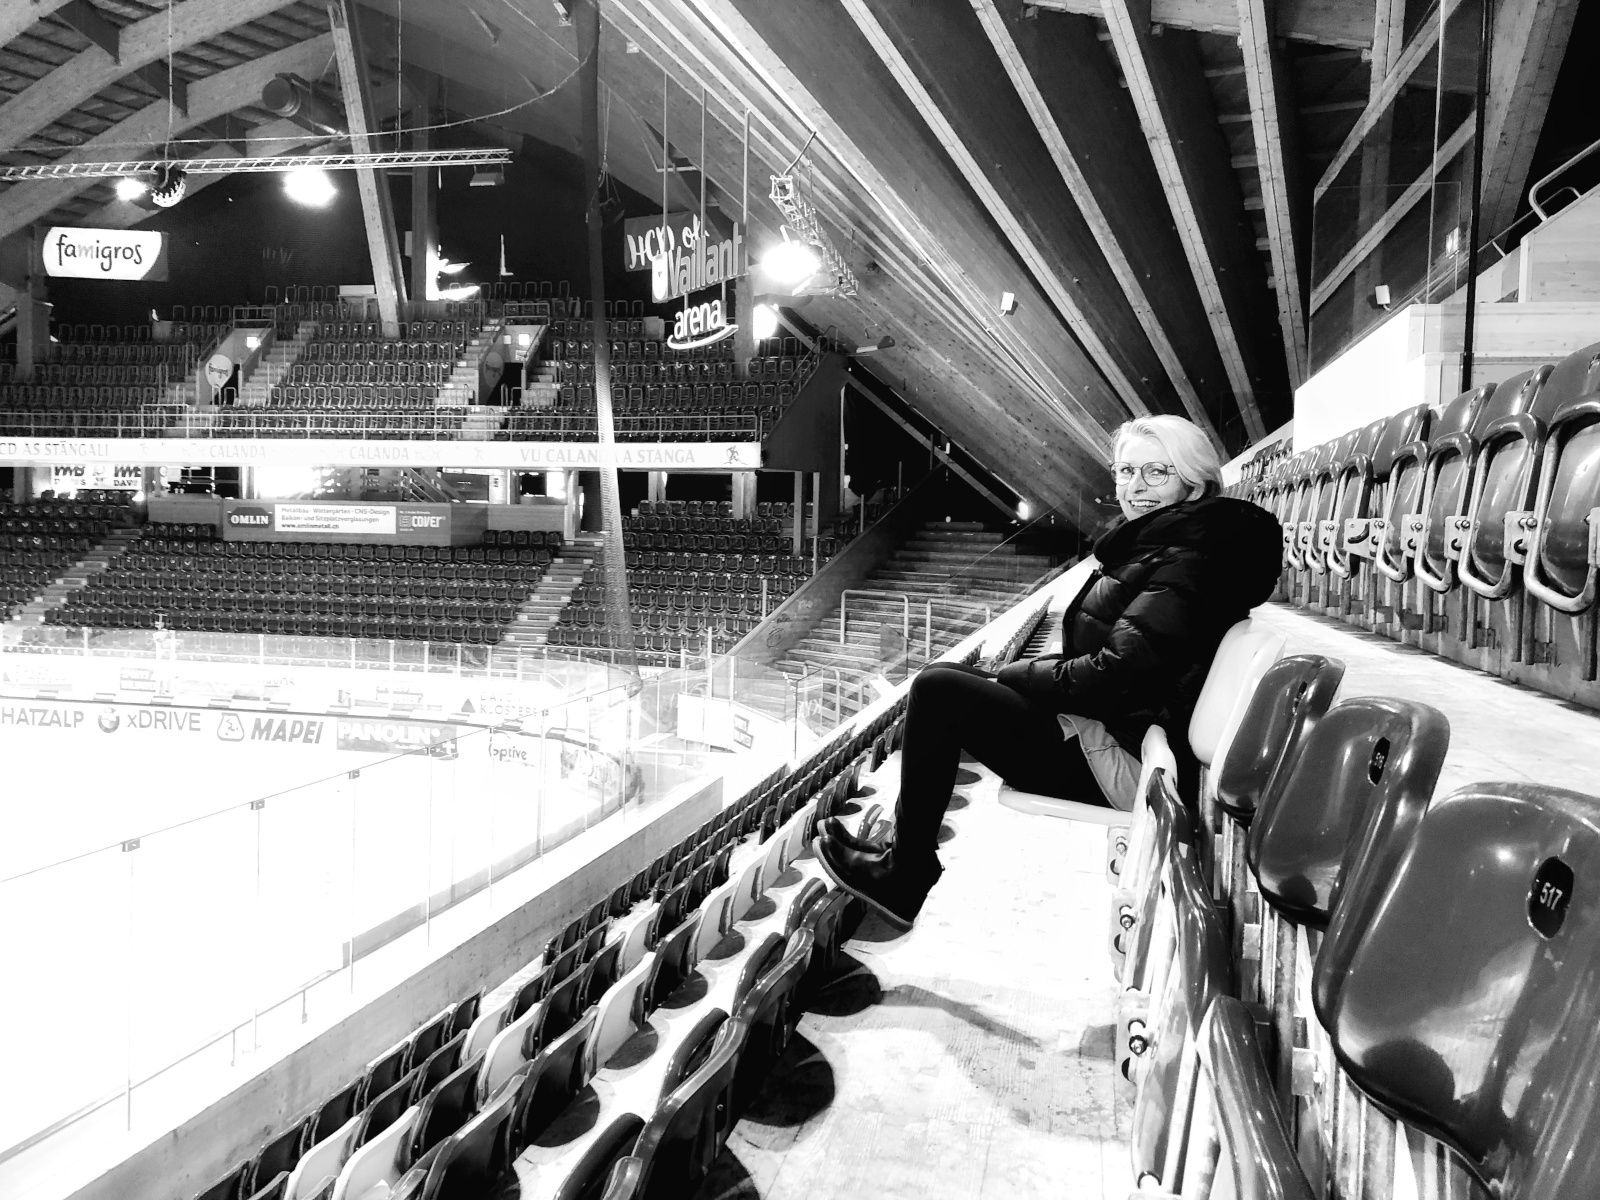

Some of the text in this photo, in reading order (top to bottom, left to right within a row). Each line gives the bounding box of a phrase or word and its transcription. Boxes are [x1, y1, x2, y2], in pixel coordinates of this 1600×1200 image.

[56, 234, 143, 271] famigros
[668, 222, 742, 296] Vaillant
[674, 300, 722, 339] arena
[22, 443, 41, 456] AS
[210, 445, 266, 459] CALANDA
[350, 446, 410, 461] CALANDA
[520, 448, 541, 463] VU
[623, 449, 633, 463] A
[637, 449, 696, 464] STANGA
[230, 515, 269, 525] OMLIN
[1, 706, 85, 728] HATZALP
[126, 709, 201, 732] xDRIVE
[251, 717, 324, 744] MAPEI
[338, 721, 431, 745] PANOLIN
[1540, 882, 1563, 911] 517
